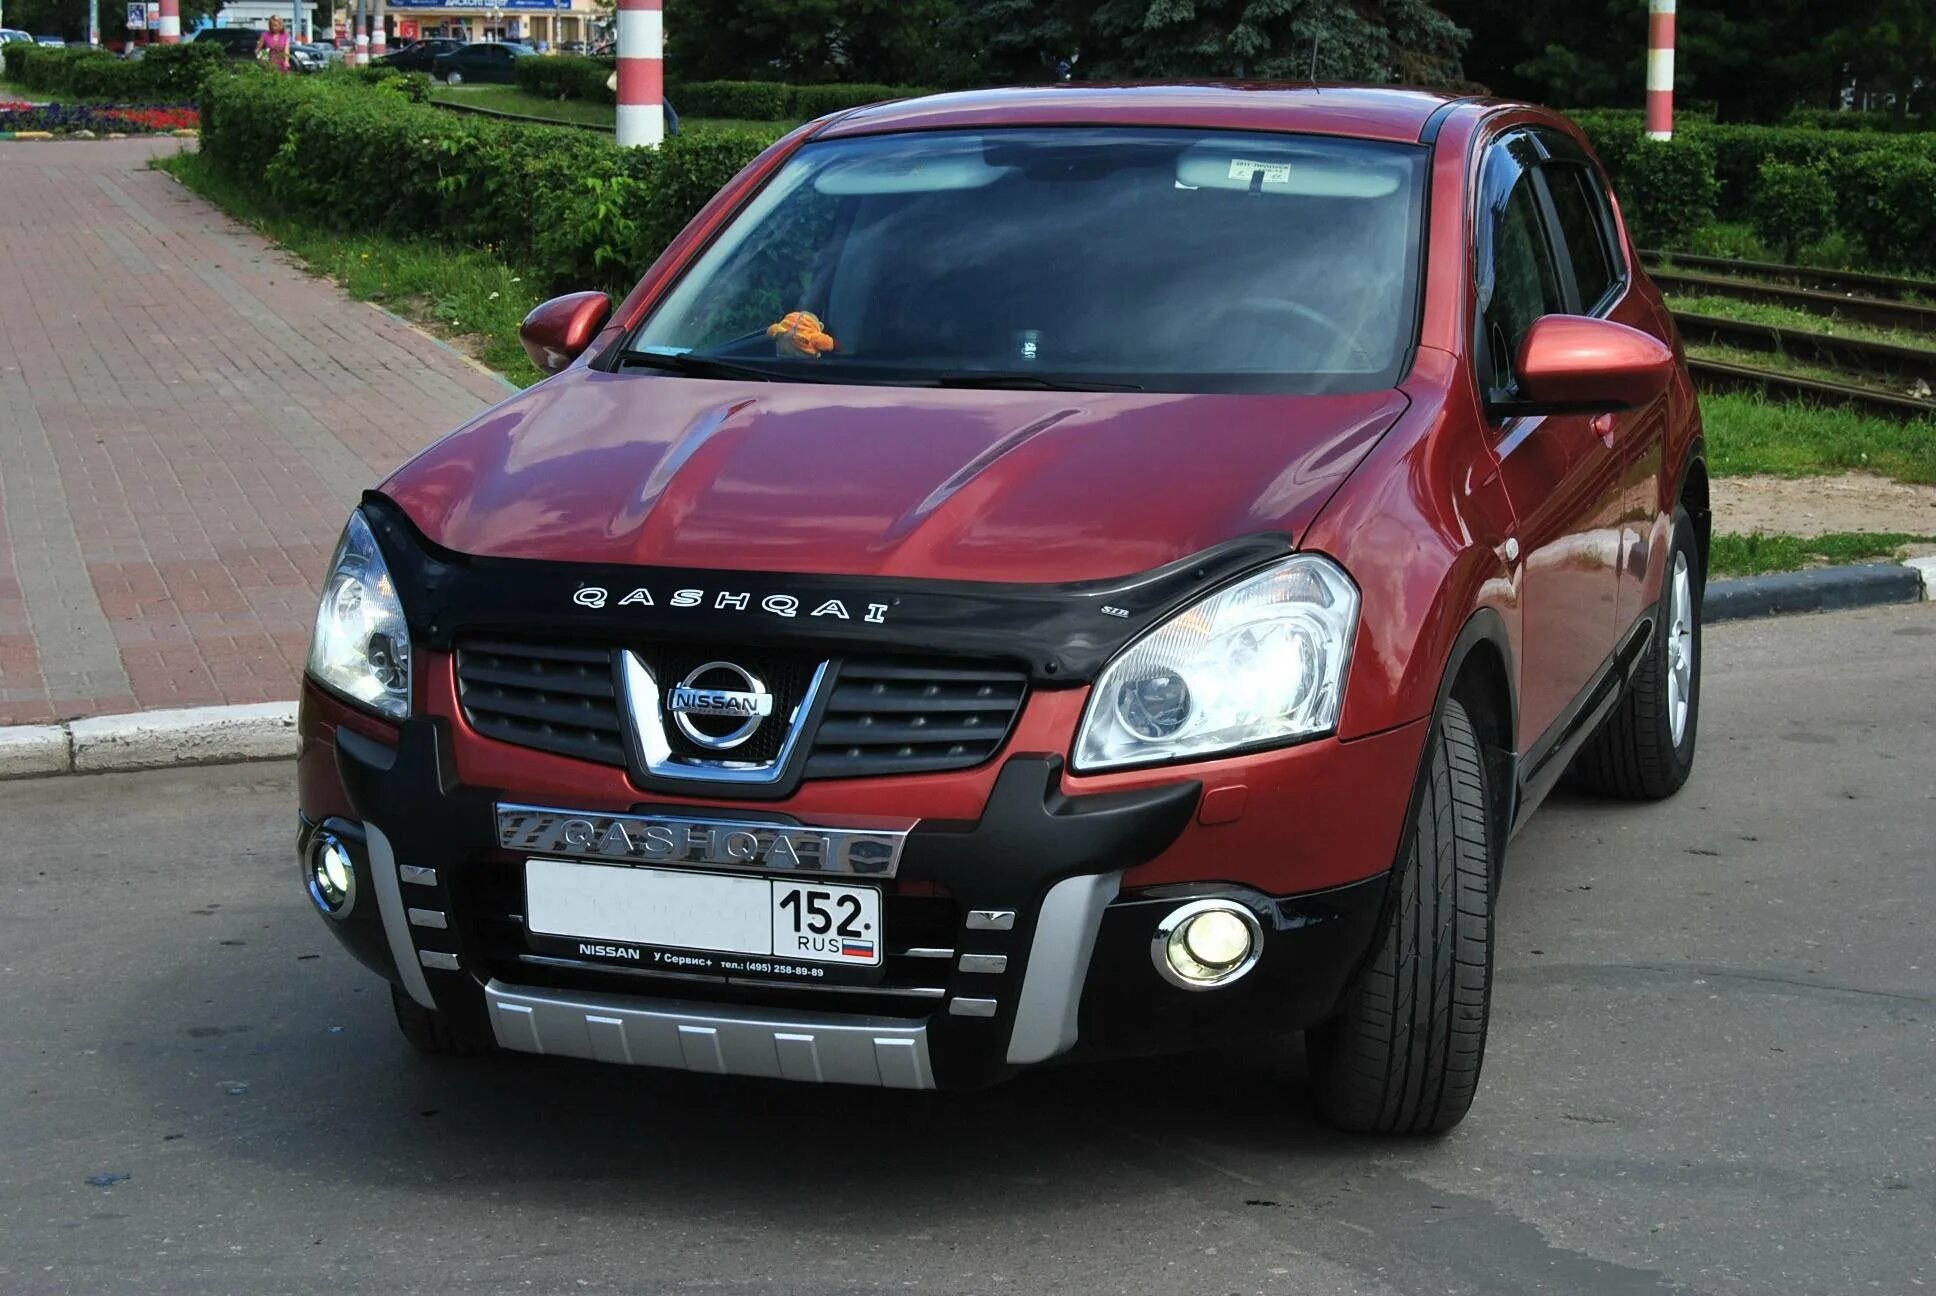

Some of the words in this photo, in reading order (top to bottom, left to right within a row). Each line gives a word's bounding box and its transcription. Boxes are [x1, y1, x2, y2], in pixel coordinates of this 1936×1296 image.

[573, 586, 888, 623] QASHQAI
[676, 693, 758, 711] NISSAN
[560, 819, 831, 865] QASHQAI
[579, 943, 640, 960] NISSAN
[746, 961, 771, 973] (495)
[774, 964, 824, 977] 258-89-89
[798, 936, 840, 953] RUS
